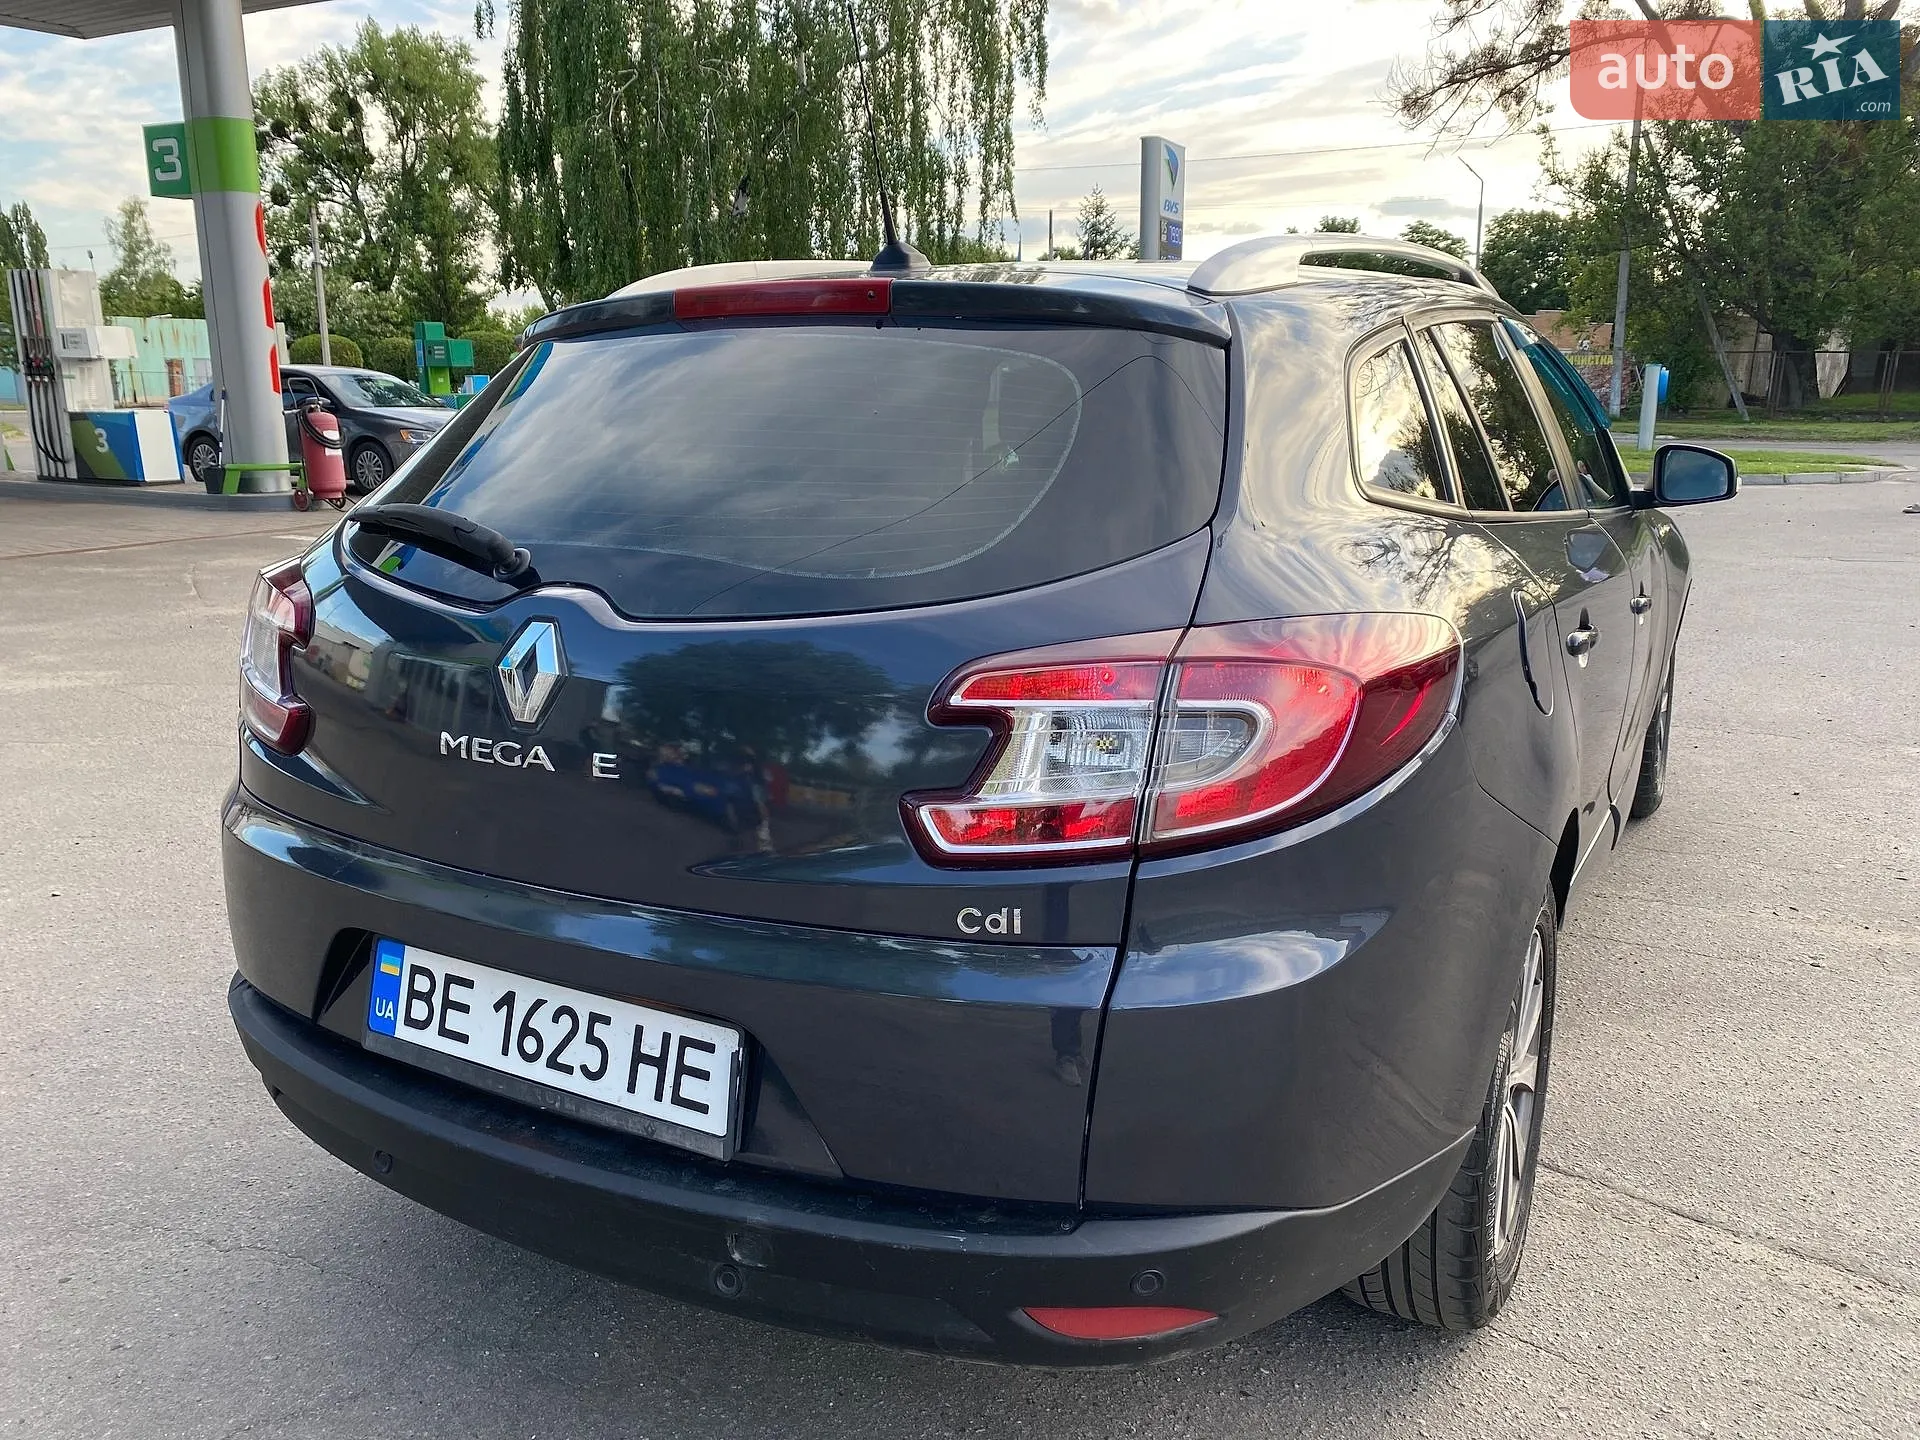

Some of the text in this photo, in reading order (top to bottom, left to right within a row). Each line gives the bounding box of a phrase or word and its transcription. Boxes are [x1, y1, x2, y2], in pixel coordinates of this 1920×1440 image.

[151, 137, 183, 182] 3
[1163, 199, 1179, 214] BVS
[94, 427, 110, 453] 3
[439, 730, 621, 779] MEGA E
[375, 997, 394, 1021] UA
[402, 963, 717, 1116] BE 1625 HE
